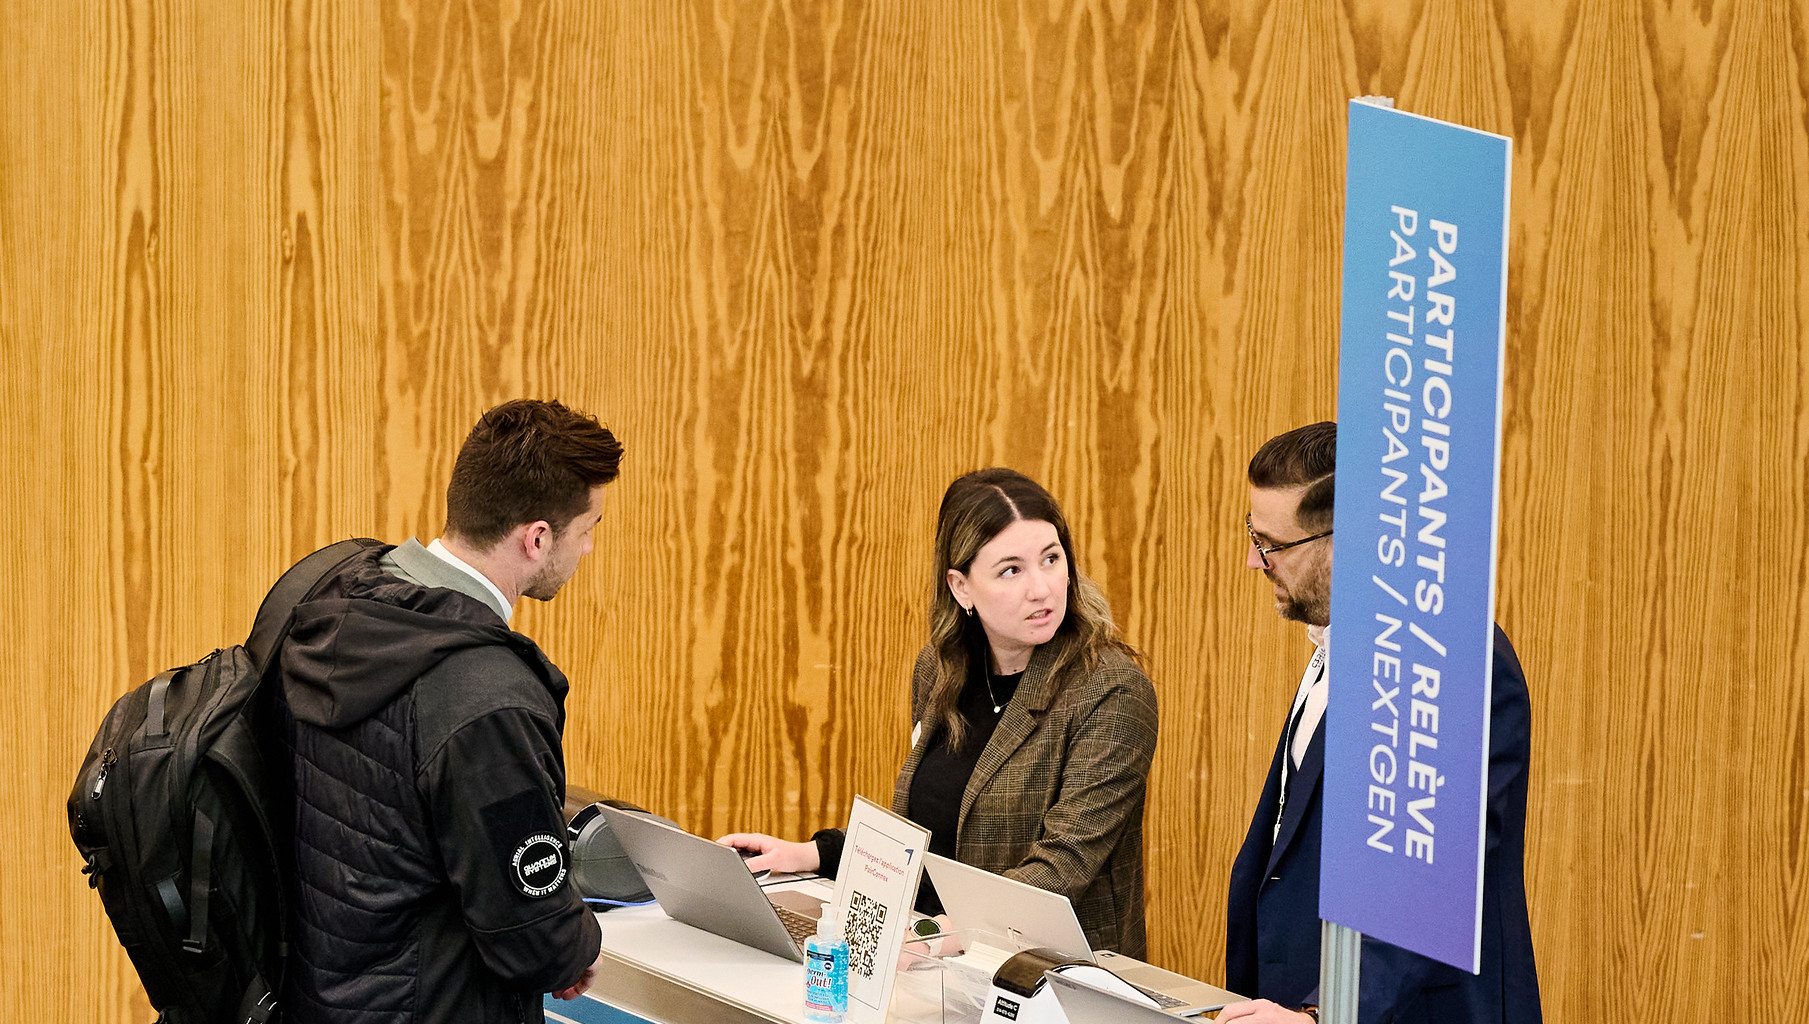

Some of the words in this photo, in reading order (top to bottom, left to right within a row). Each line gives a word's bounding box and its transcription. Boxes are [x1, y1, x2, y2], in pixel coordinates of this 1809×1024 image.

[1377, 204, 1418, 568] PARTICIPANTS
[1414, 218, 1458, 616] PARTICIPANTS
[1372, 574, 1408, 606] /
[1409, 621, 1447, 657] /
[1366, 612, 1403, 853] NEXTGEN
[1405, 663, 1446, 865] RELÈVE
[511, 845, 525, 867] AERIAL
[524, 834, 563, 849] INTELLIGENCE
[810, 975, 832, 988] Out!
